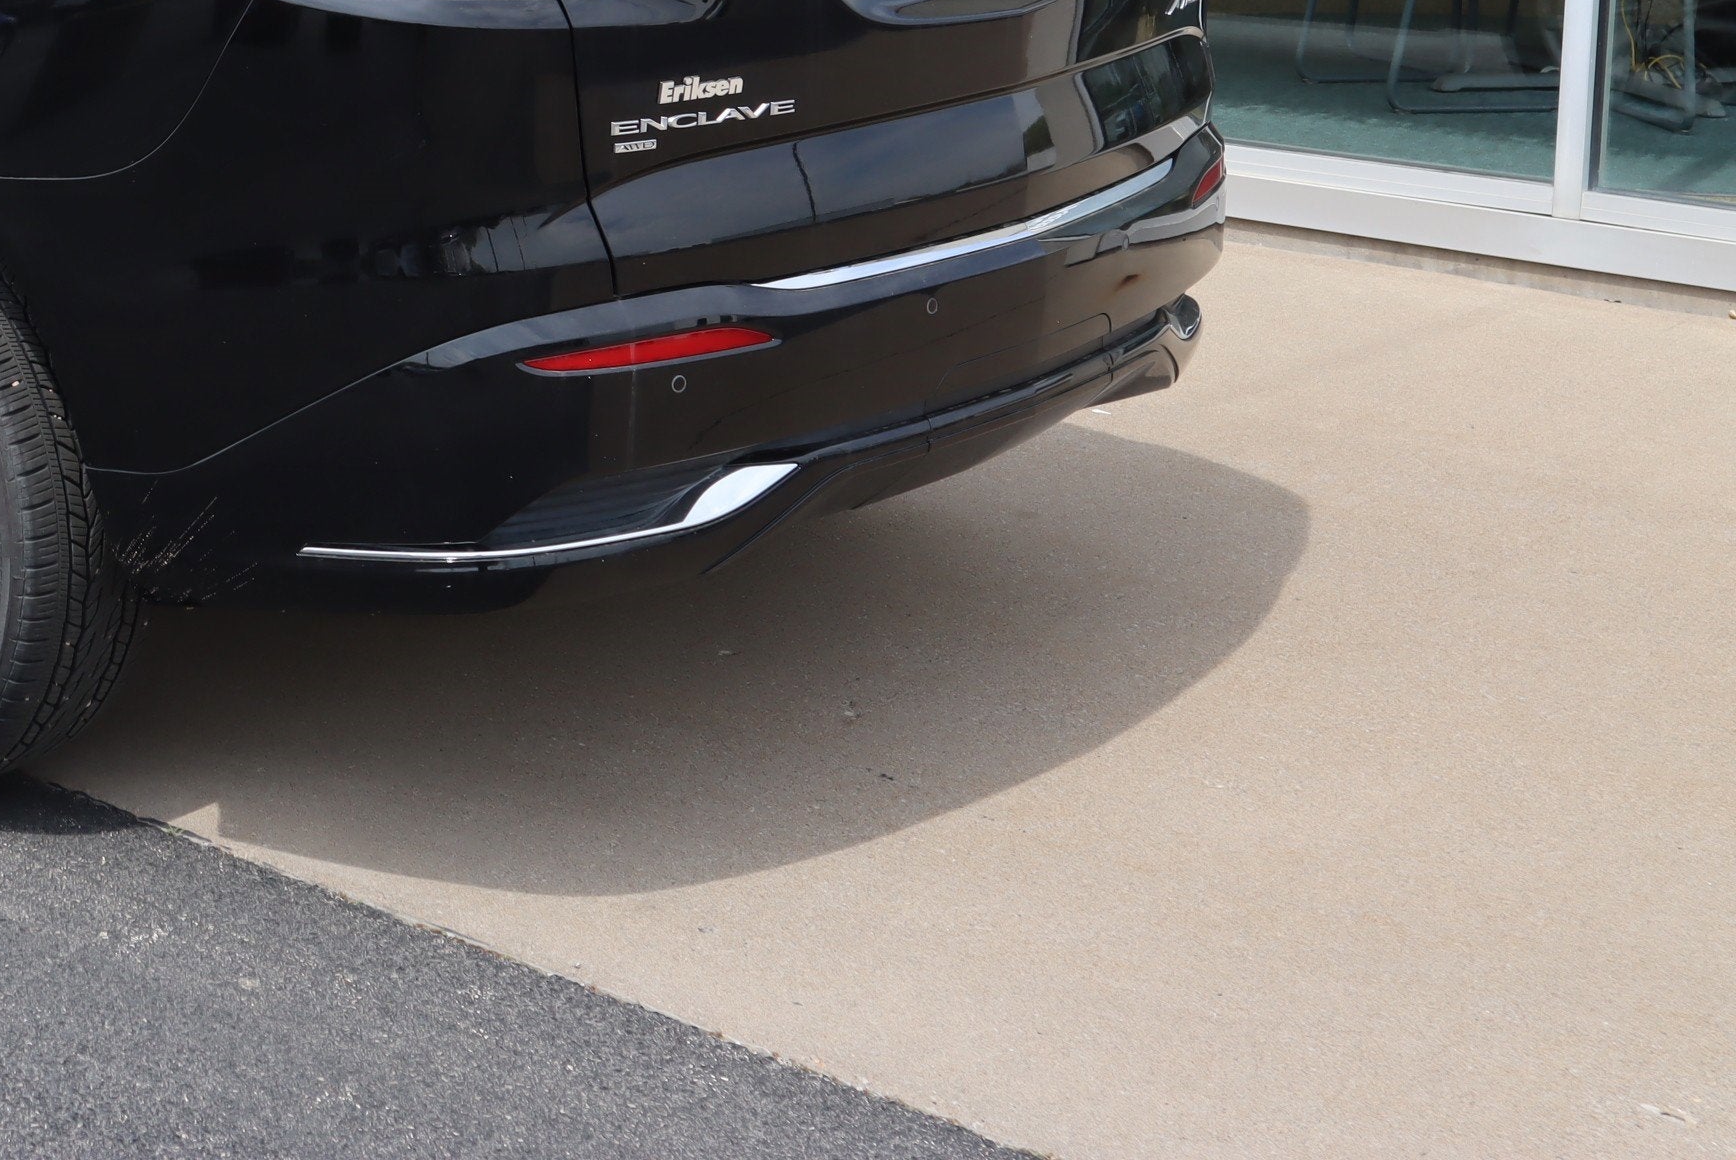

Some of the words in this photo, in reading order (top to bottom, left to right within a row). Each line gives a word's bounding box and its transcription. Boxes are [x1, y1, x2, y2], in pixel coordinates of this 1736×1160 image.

[657, 75, 744, 105] Eriksen
[611, 99, 795, 136] ENCLAVE
[617, 139, 656, 153] AWD
